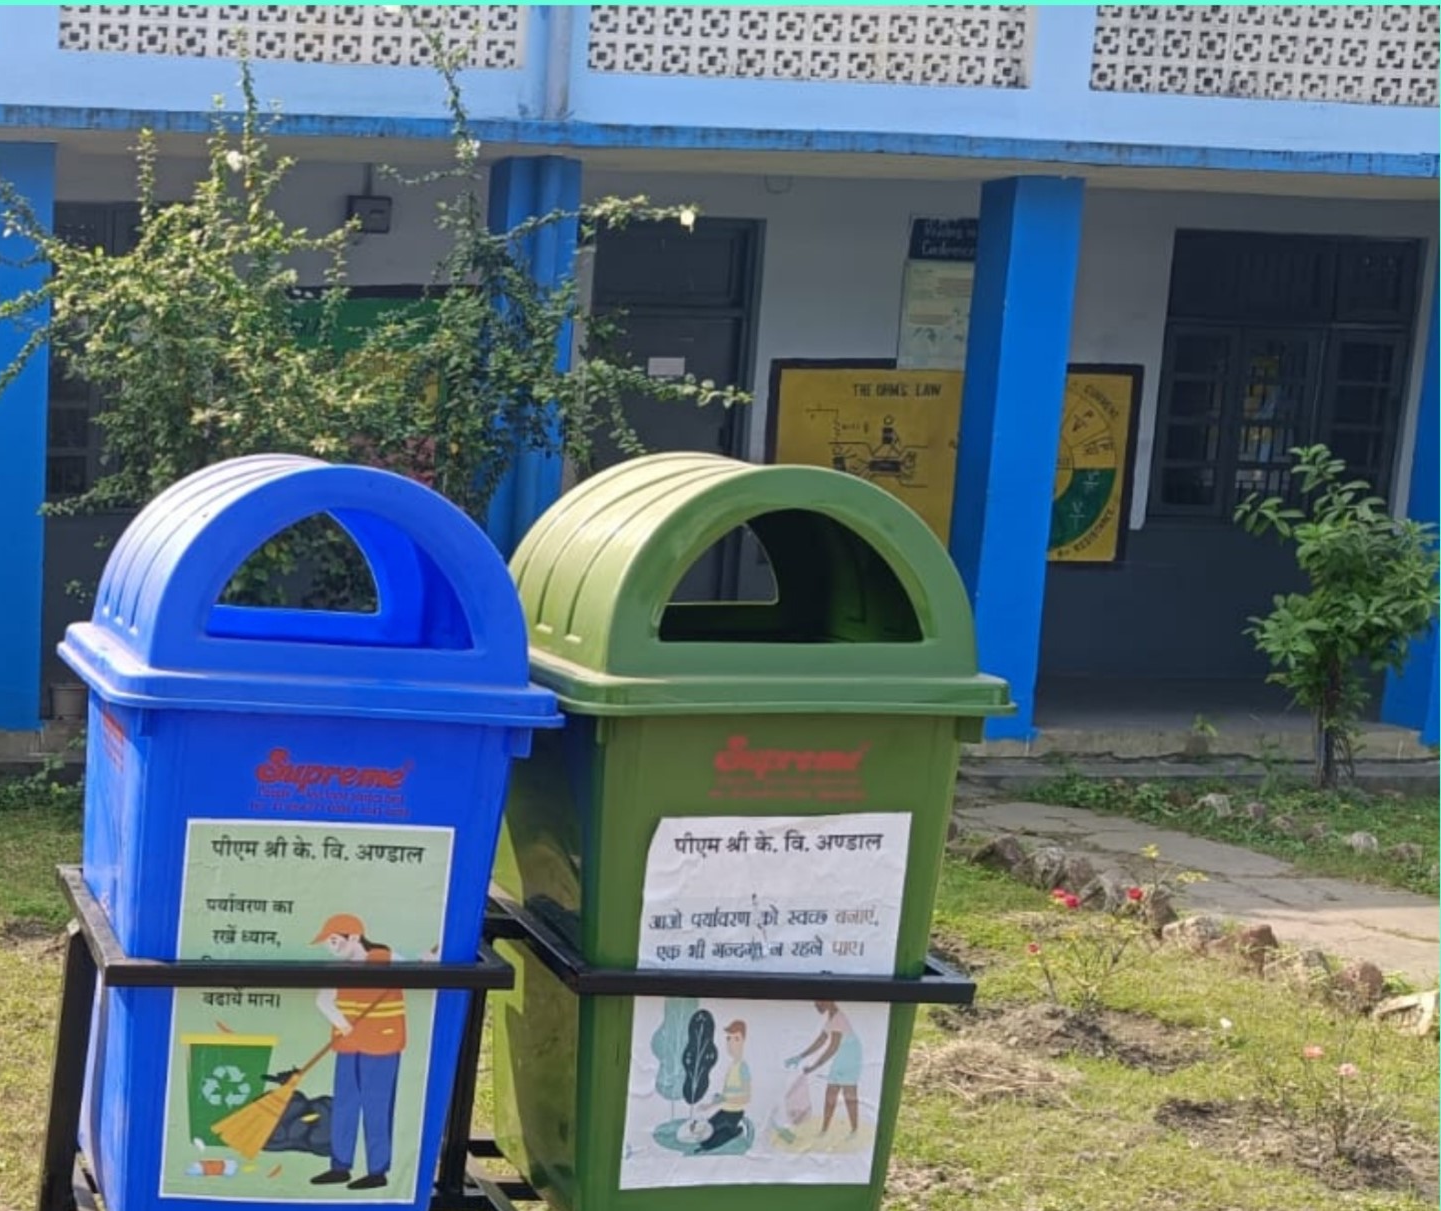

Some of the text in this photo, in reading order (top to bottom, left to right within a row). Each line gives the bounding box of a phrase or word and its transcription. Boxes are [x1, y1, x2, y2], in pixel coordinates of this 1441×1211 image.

[853, 383, 871, 397] THE
[211, 834, 426, 863] पीएम श्री के. वि. अण्डाल
[674, 829, 884, 858] पीएम श्री के. वि. अण्डाल
[272, 900, 294, 914] का
[649, 909, 682, 930] आओ
[691, 907, 752, 928] पर्यावरण
[241, 930, 281, 947] ध्यान,
[656, 945, 681, 962] एक
[688, 938, 706, 960] भी
[770, 942, 784, 957] न
[791, 935, 823, 958] रहने
